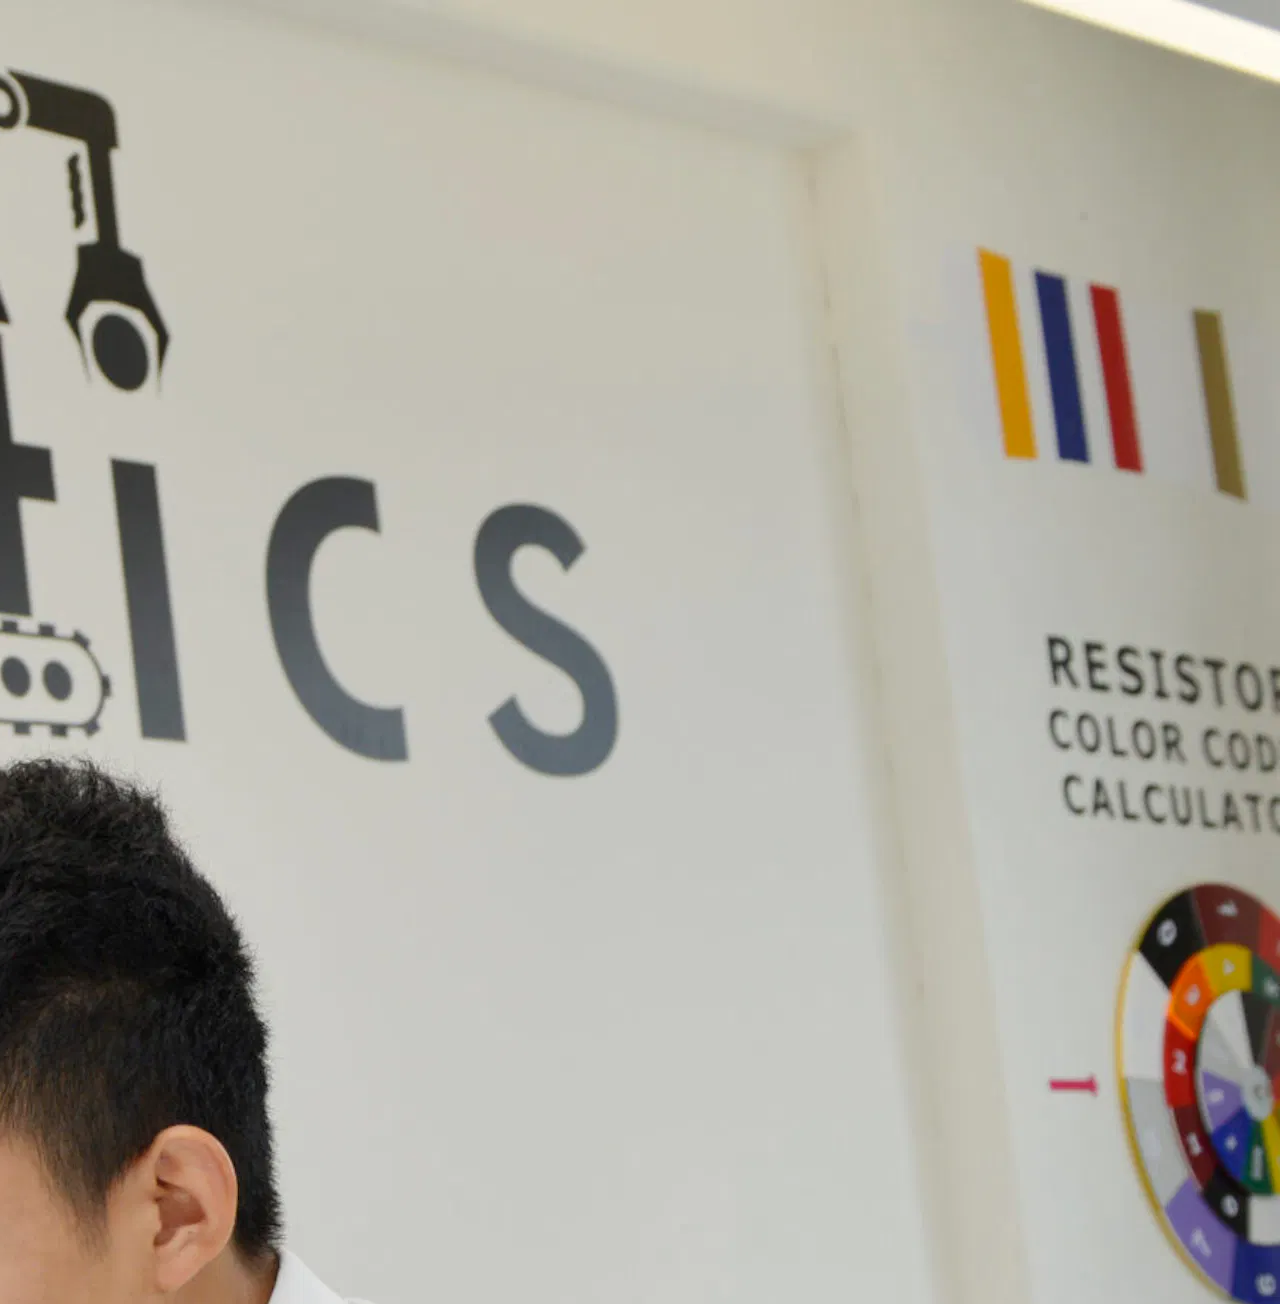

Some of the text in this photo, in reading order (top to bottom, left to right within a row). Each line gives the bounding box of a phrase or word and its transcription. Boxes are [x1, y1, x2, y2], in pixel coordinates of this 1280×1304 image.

[1048, 708, 1280, 773] COLOR COD
[1062, 774, 1280, 836] CALCULATO
